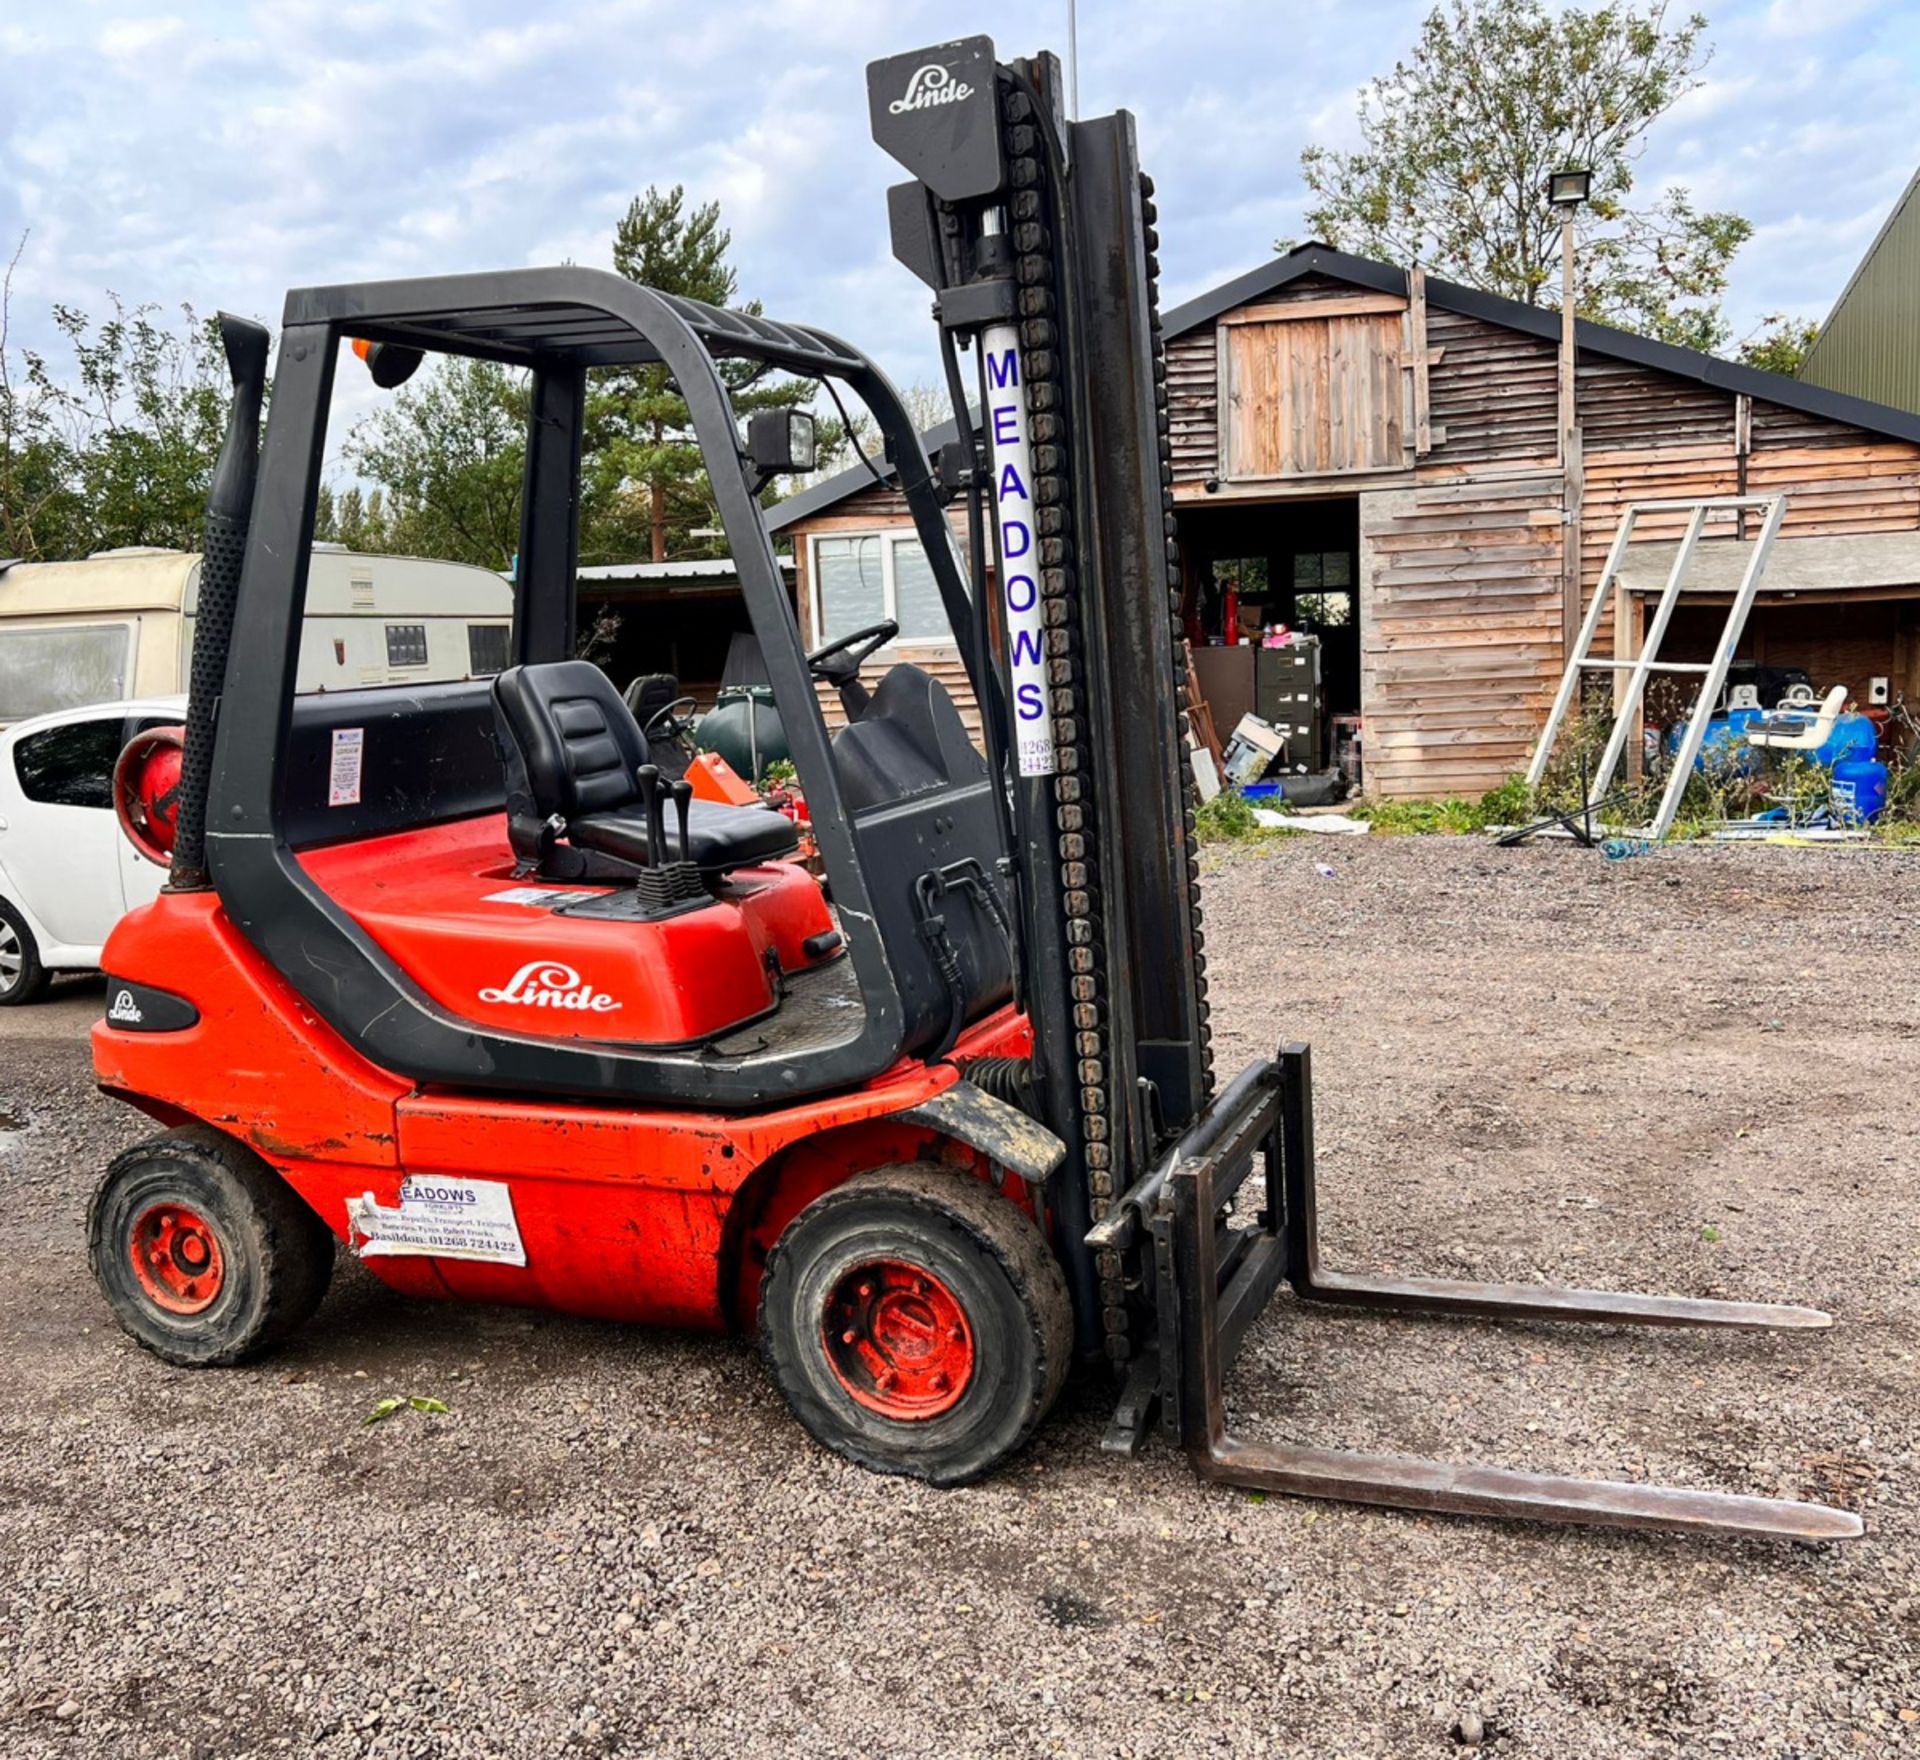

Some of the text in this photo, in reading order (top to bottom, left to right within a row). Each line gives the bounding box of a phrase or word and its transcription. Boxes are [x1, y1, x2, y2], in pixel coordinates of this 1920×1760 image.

[889, 64, 975, 114] Linde
[986, 349, 1044, 721] MEADOWS
[1021, 739, 1050, 755] 1268
[478, 961, 622, 1012] Linde
[108, 989, 143, 1022] Linde
[401, 1187, 476, 1203] EADOWS
[429, 1236, 467, 1247] 01268
